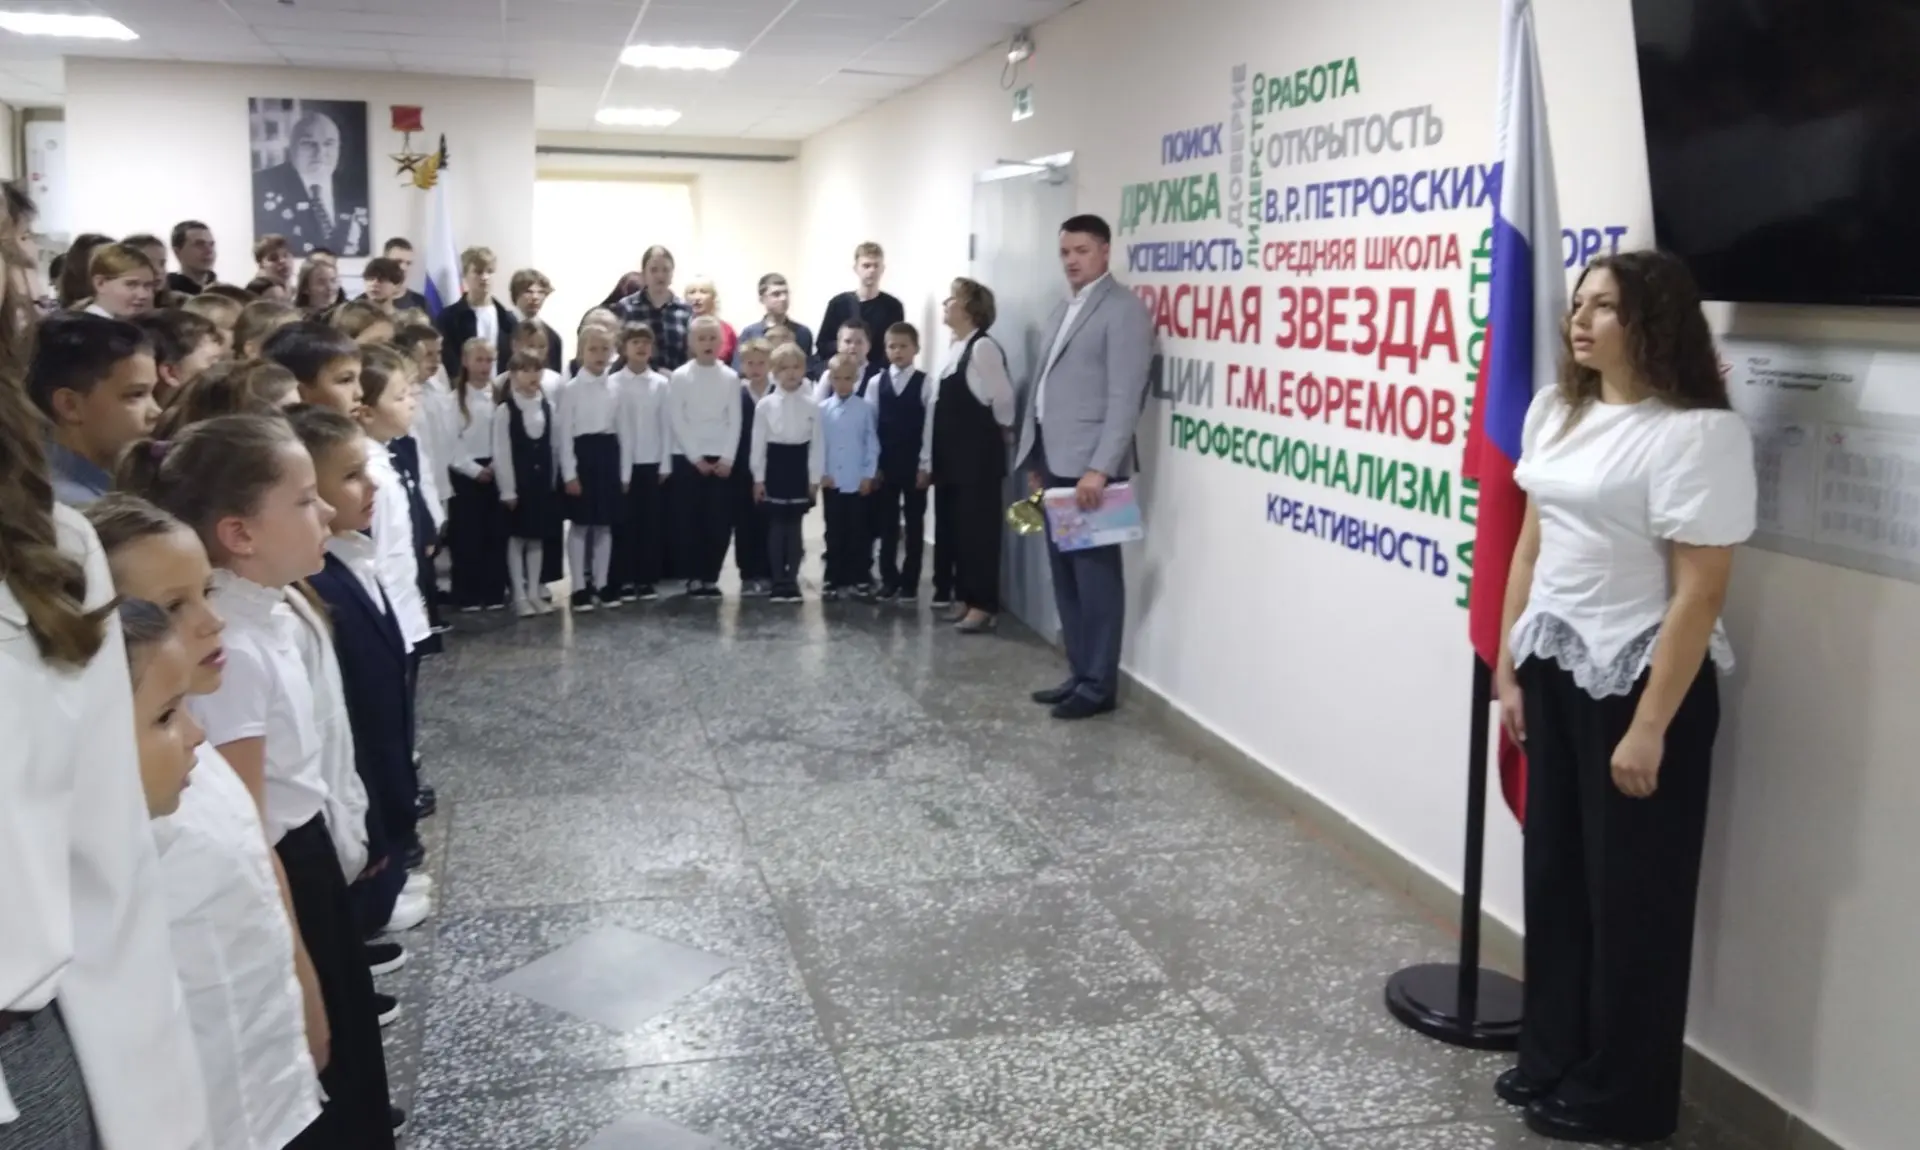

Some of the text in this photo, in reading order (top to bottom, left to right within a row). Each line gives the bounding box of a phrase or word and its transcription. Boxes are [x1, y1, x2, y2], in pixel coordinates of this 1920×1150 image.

[1267, 56, 1360, 113] РАБОТА
[1161, 121, 1223, 167] ПОИСК
[1228, 63, 1247, 229] ДОВЕРИЕ
[1267, 104, 1444, 168] ОТКРЫТОСТЬ
[1247, 72, 1265, 269] ЛИДЕРСТВО
[1118, 172, 1221, 236] ДРУЖБА
[1127, 238, 1243, 273] УСПЕШНОСТЬ
[1263, 233, 1462, 276] СРЕДНЯЯ ШКОЛА
[1561, 226, 1627, 268] ОРТ
[1133, 284, 1459, 374] РАСНАЯ ЗВЕЗДА
[1226, 363, 1455, 444] Г.М.ЕФРЕМОВ
[1170, 414, 1451, 519] ПРОФЕССИОНАЛИЗМ
[1266, 492, 1449, 577] КРЕАТИВНОСТЬ
